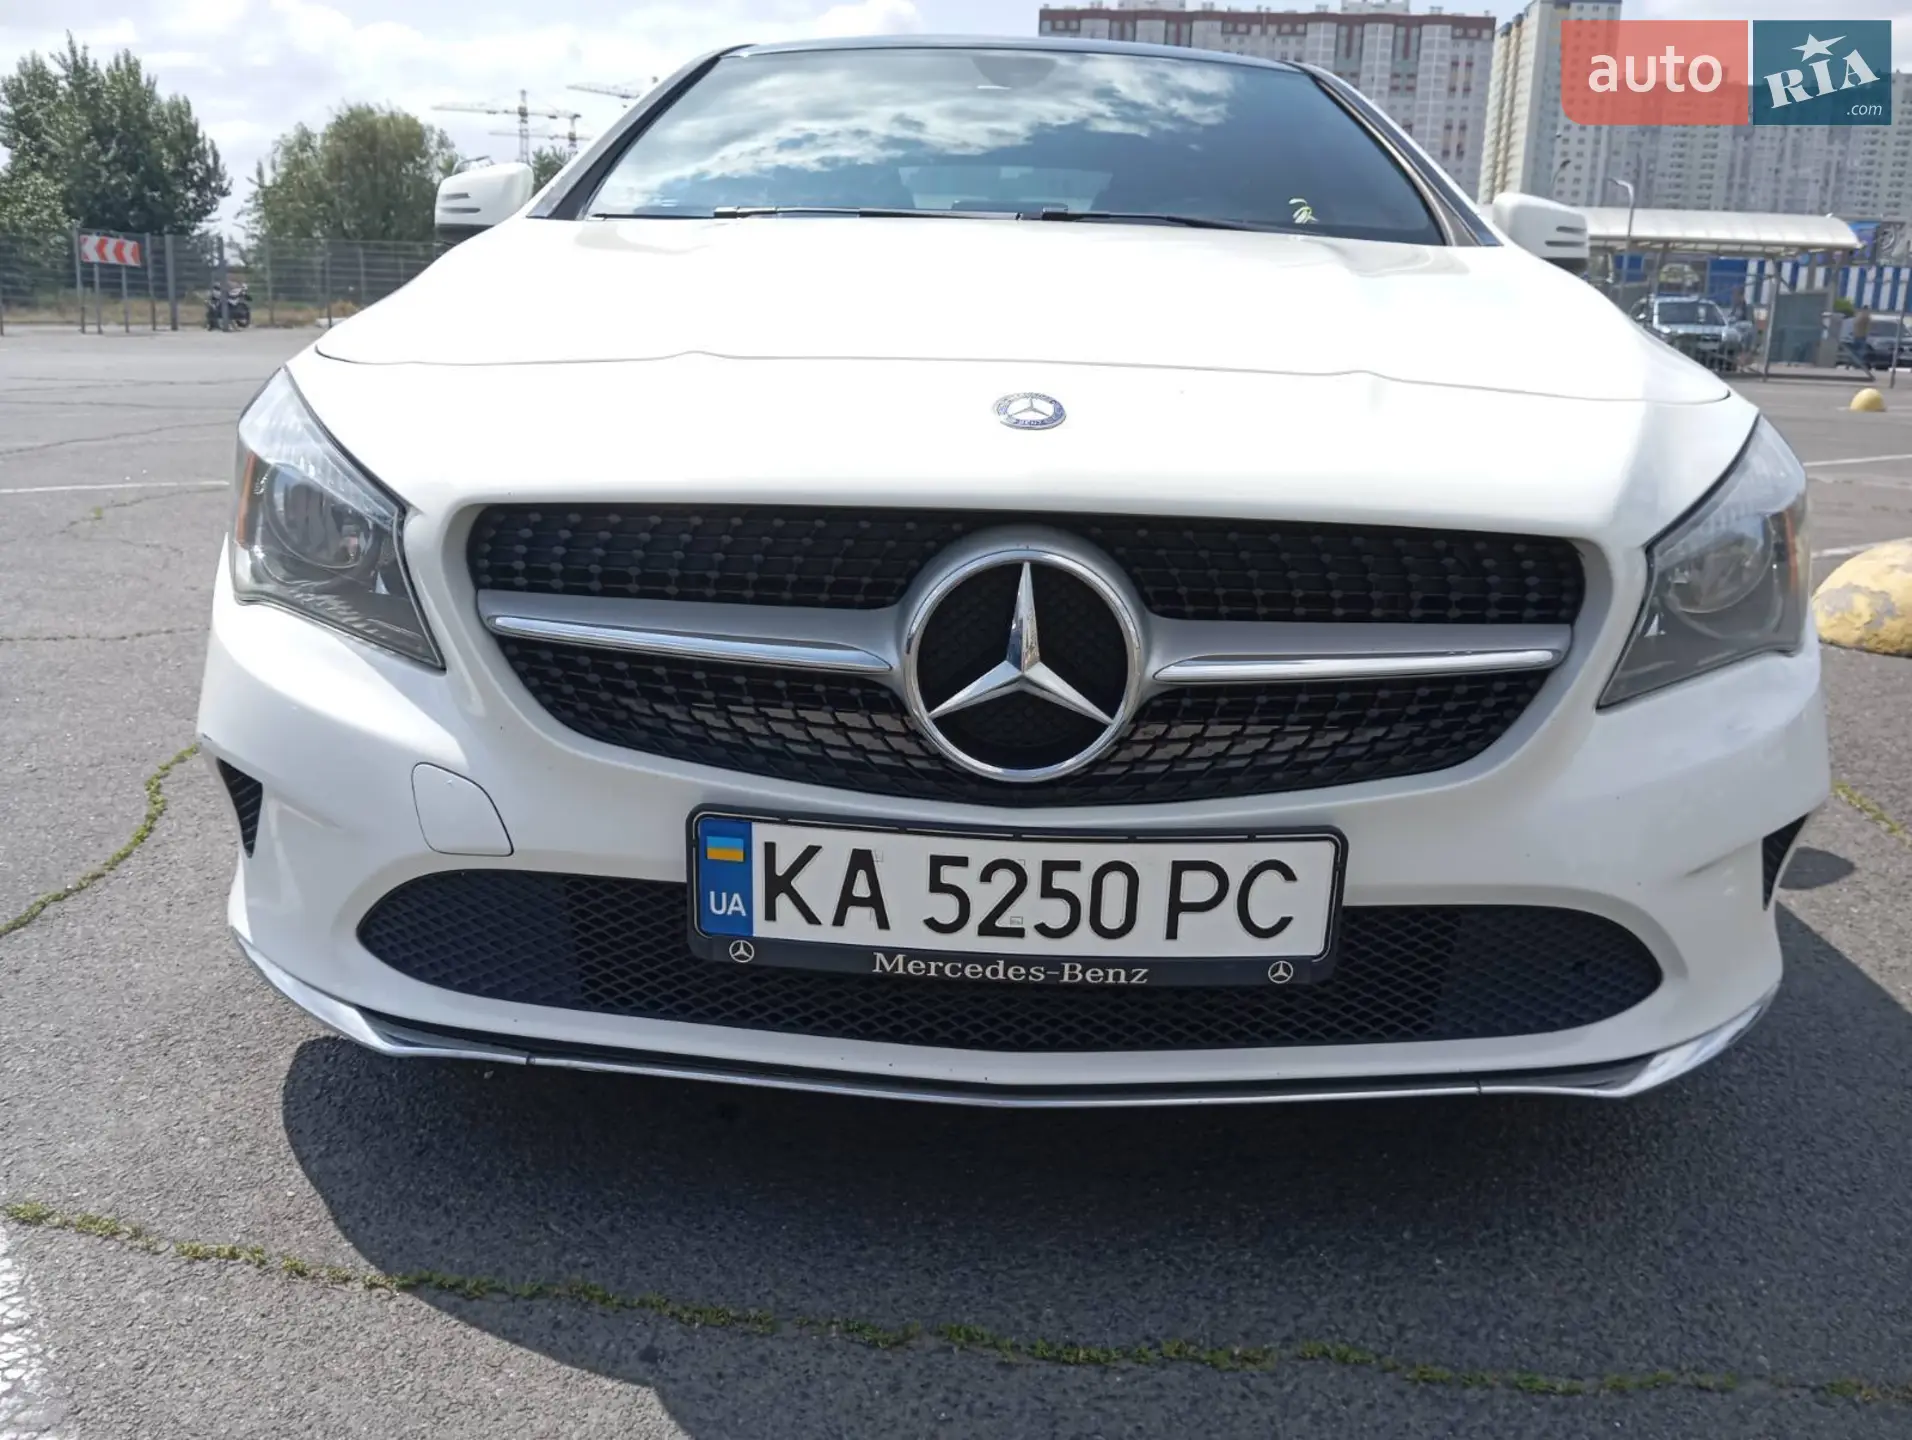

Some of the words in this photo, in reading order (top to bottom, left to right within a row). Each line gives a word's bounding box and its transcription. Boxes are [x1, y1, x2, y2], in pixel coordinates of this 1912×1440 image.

[709, 890, 747, 917] UA
[762, 841, 892, 931] KA
[922, 855, 1140, 940] 5250
[1165, 859, 1298, 941] PC
[871, 951, 1150, 985] Mercedes-Benz
